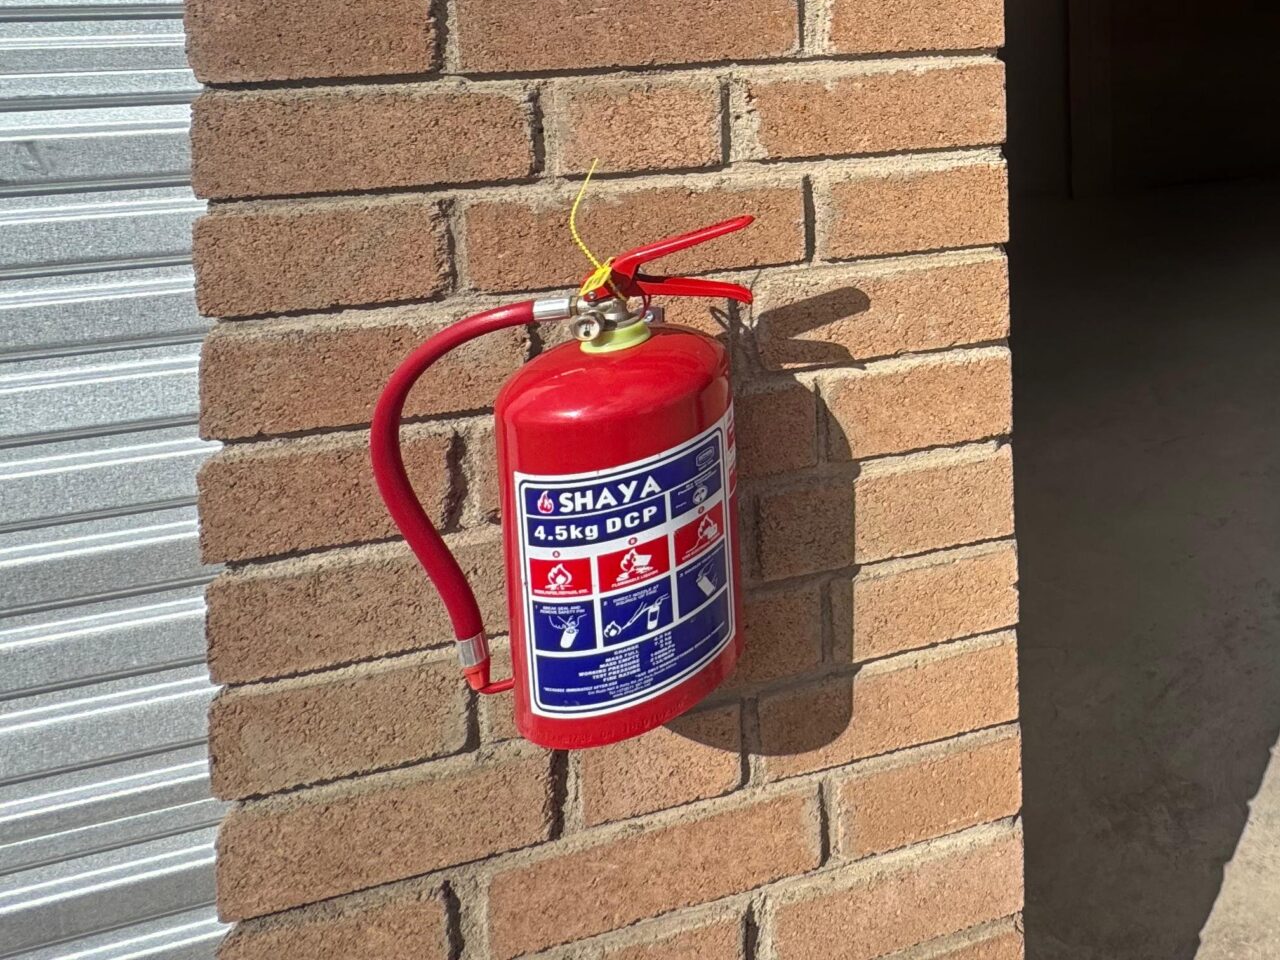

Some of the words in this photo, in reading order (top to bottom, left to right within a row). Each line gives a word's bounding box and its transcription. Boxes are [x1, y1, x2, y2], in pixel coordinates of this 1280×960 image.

[558, 475, 662, 513] SHAYA
[534, 524, 599, 540] 4.5kg
[606, 505, 658, 534] DCP
